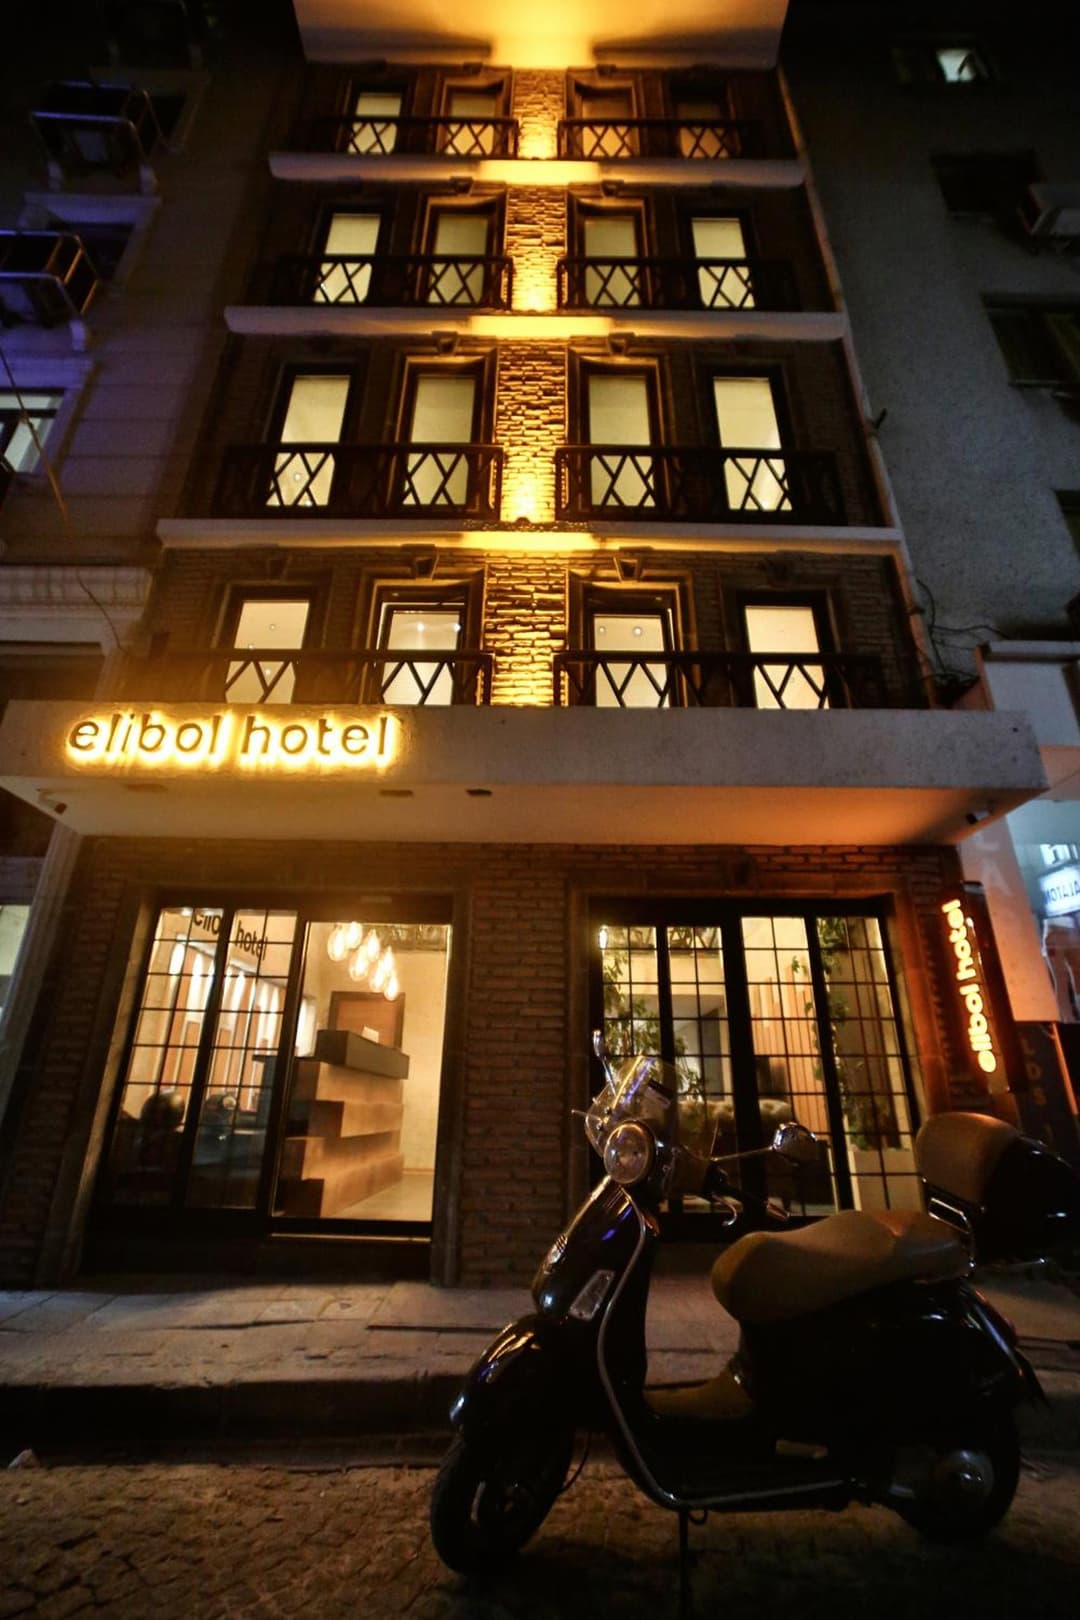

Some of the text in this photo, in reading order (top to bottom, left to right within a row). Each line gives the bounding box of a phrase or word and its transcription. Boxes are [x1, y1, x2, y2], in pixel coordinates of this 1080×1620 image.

[68, 713, 389, 755] elibol hotel
[234, 919, 268, 961] hotel
[941, 899, 997, 1073] elibol hotel
